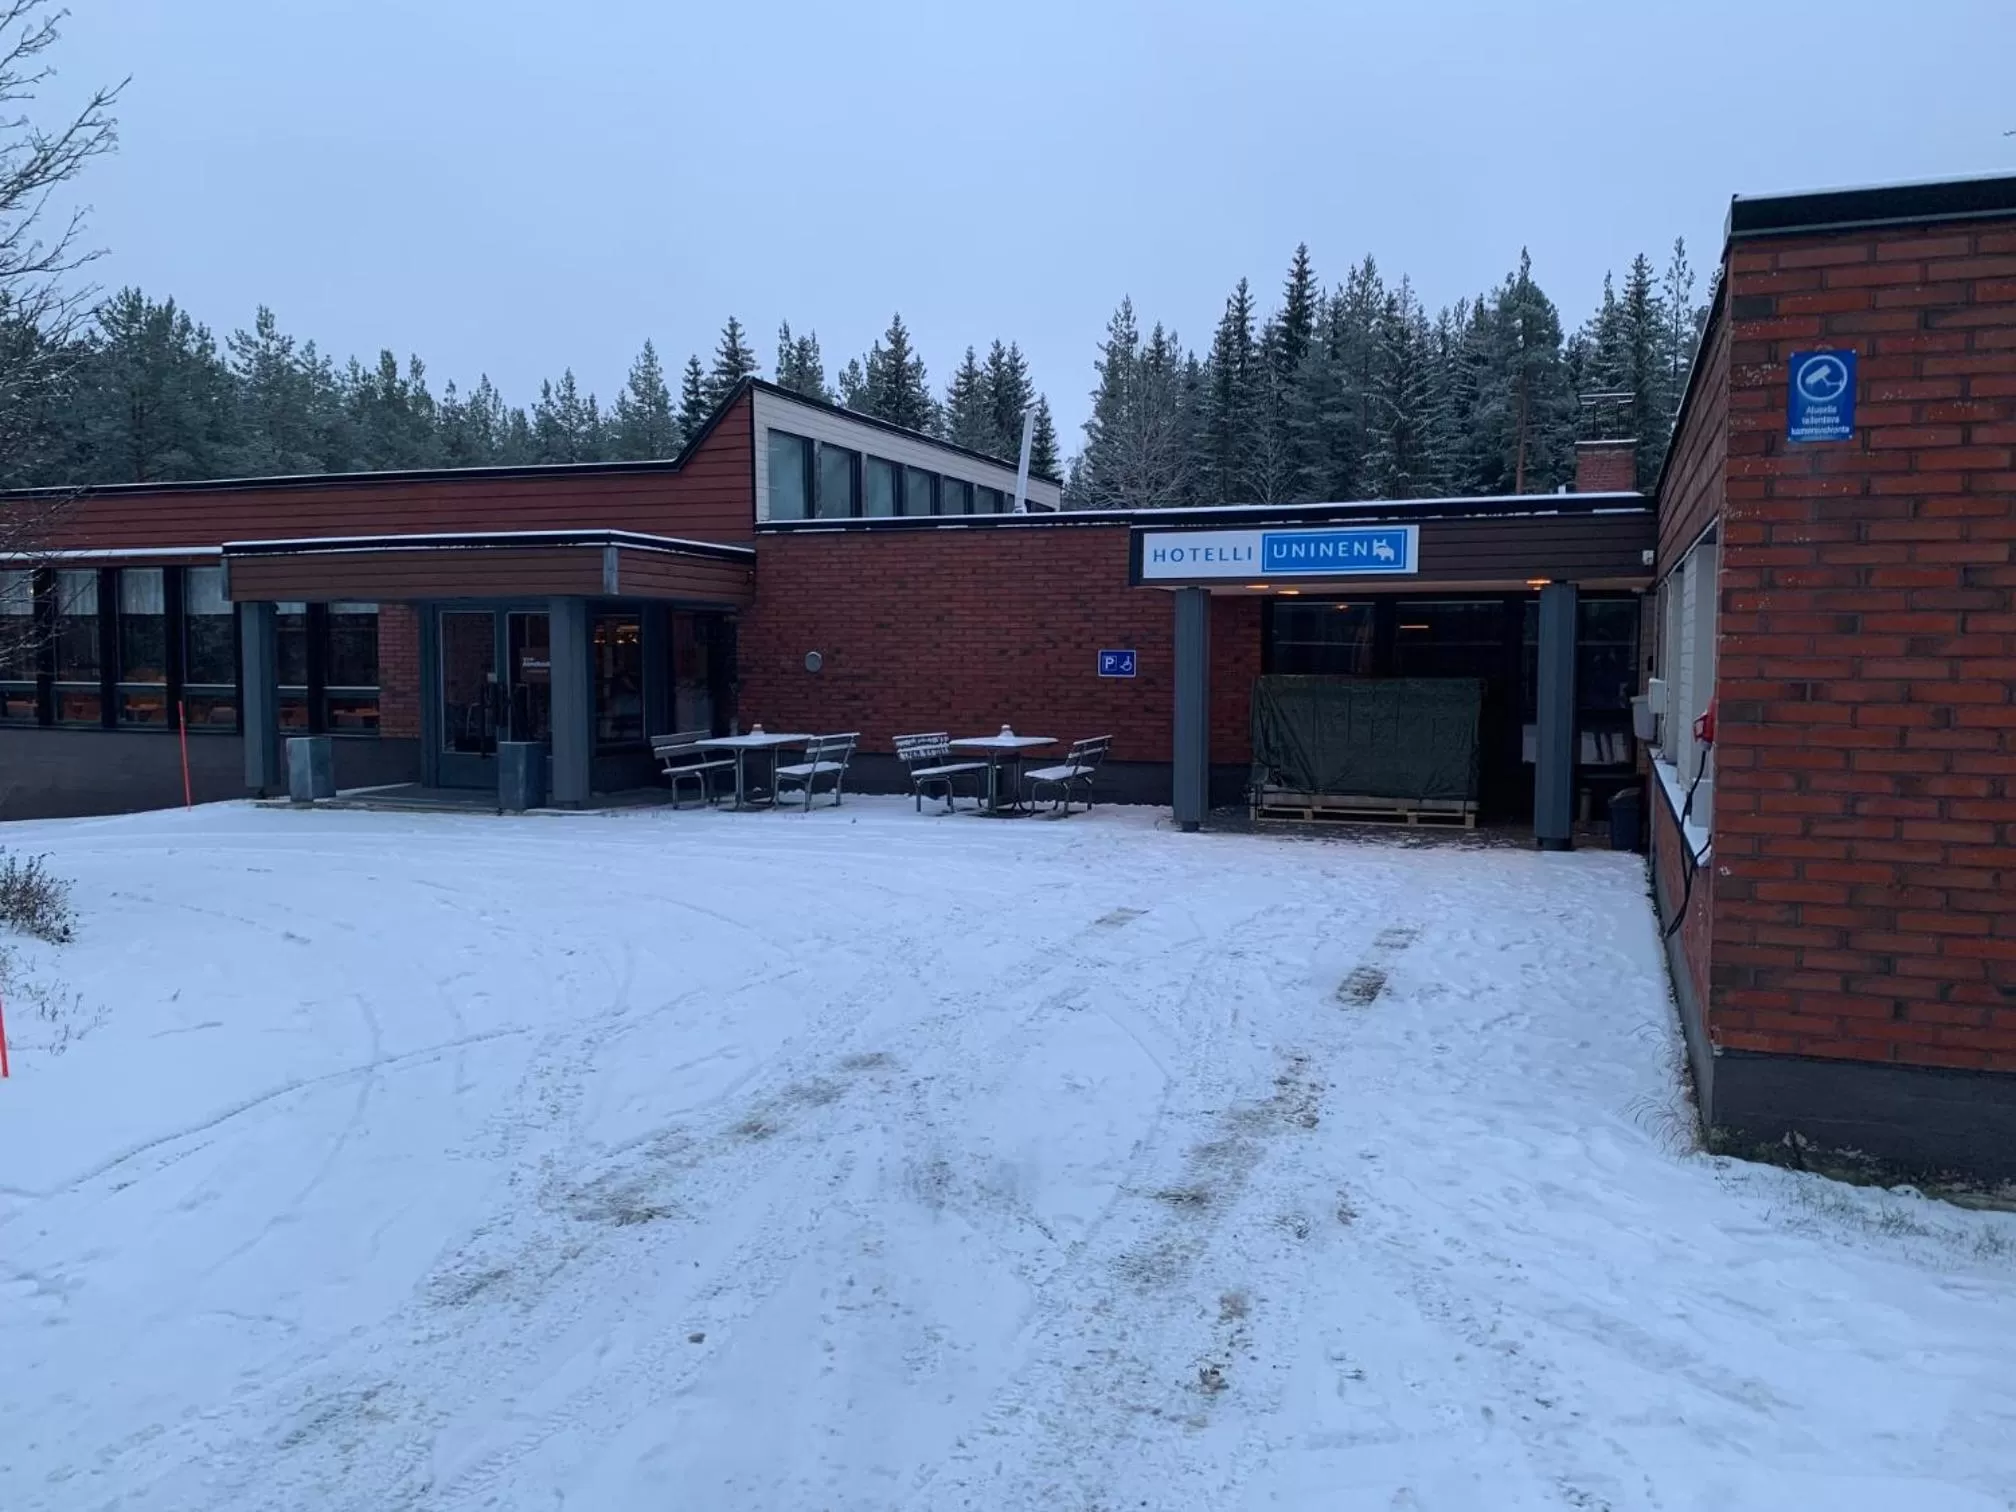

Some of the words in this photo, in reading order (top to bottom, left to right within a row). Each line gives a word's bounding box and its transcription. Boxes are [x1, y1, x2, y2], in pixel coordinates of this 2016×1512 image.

[1153, 547, 1252, 563] HOTELLI
[1273, 541, 1367, 558] UNINEN
[1105, 656, 1115, 669] P
